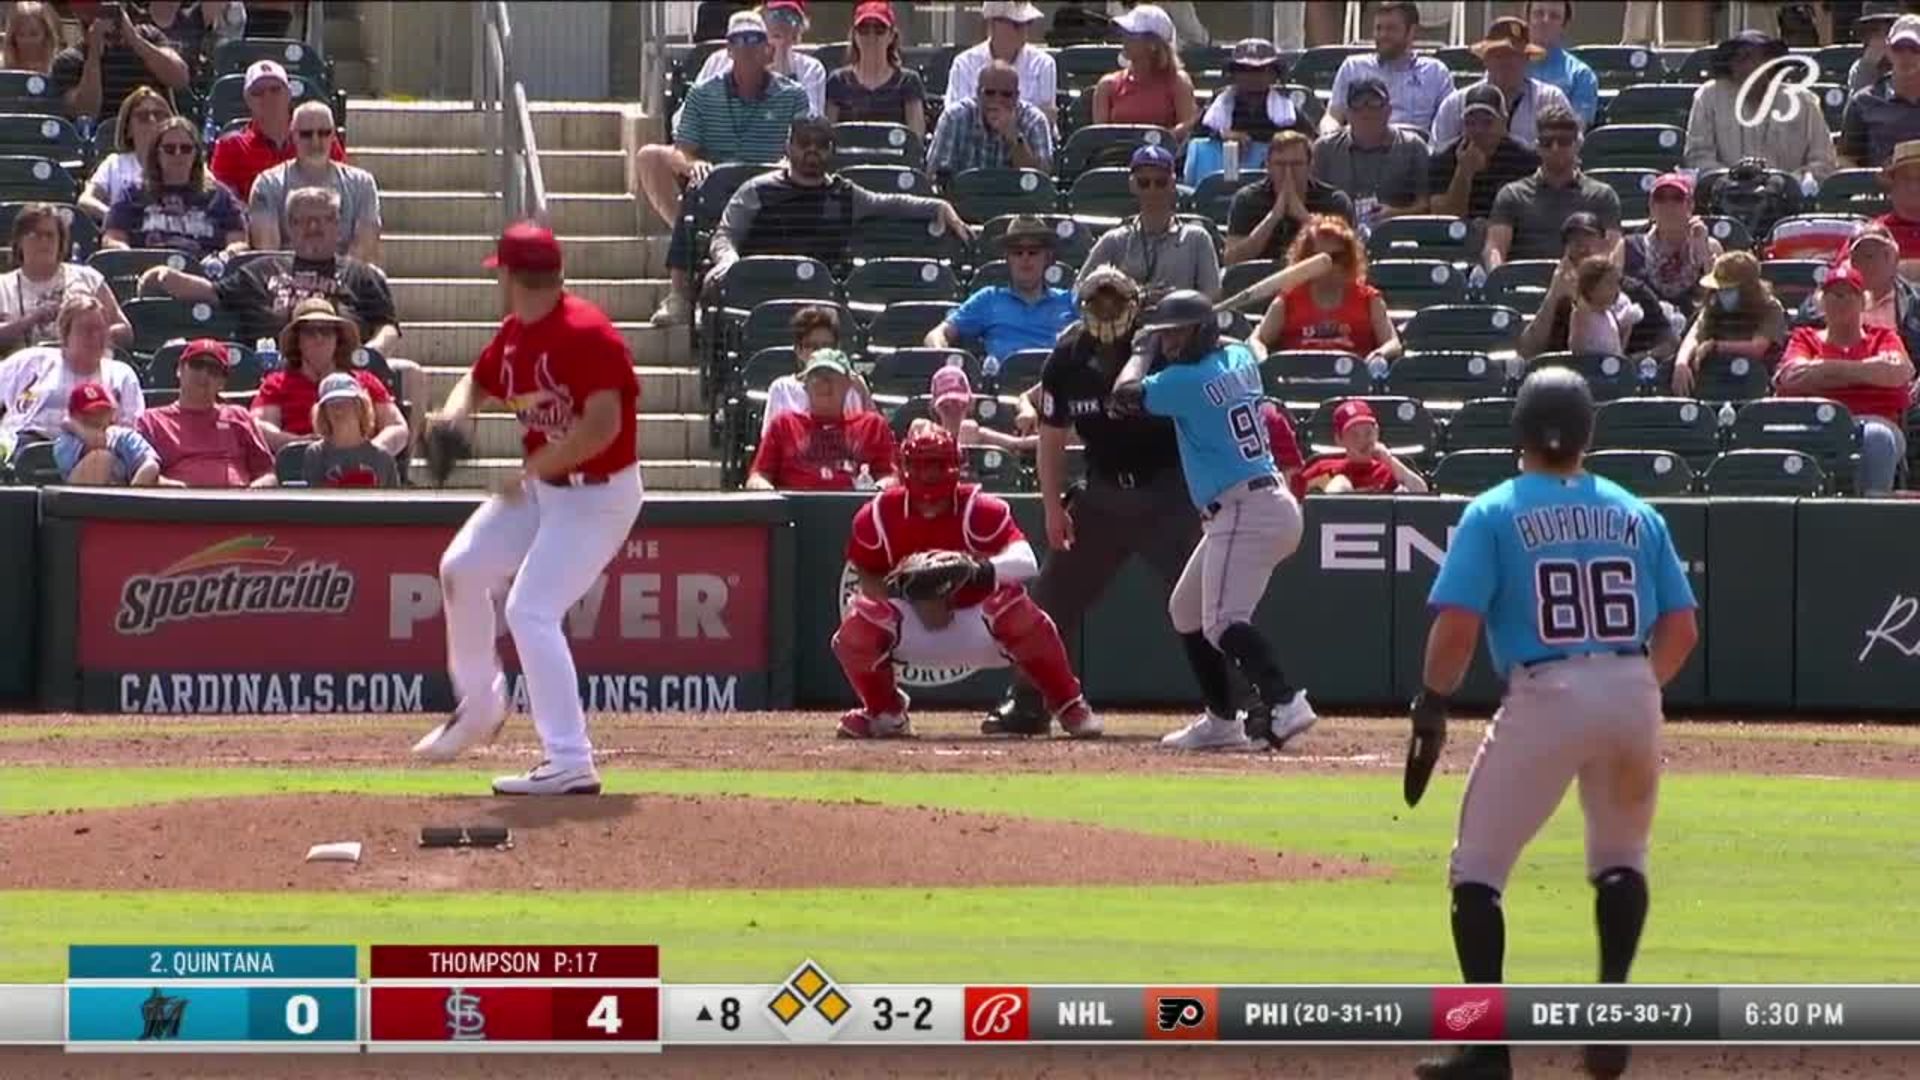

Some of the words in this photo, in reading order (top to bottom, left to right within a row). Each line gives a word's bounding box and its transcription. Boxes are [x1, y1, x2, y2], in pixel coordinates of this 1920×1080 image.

[1229, 401, 1268, 462] 9
[626, 540, 660, 559] HE
[1320, 523, 1453, 572] EN
[1515, 502, 1642, 551] BURDICK
[116, 560, 354, 635] Spectracide
[1535, 556, 1636, 643] 86
[1859, 594, 1920, 662] R
[120, 673, 424, 713] CARDINALS.COM
